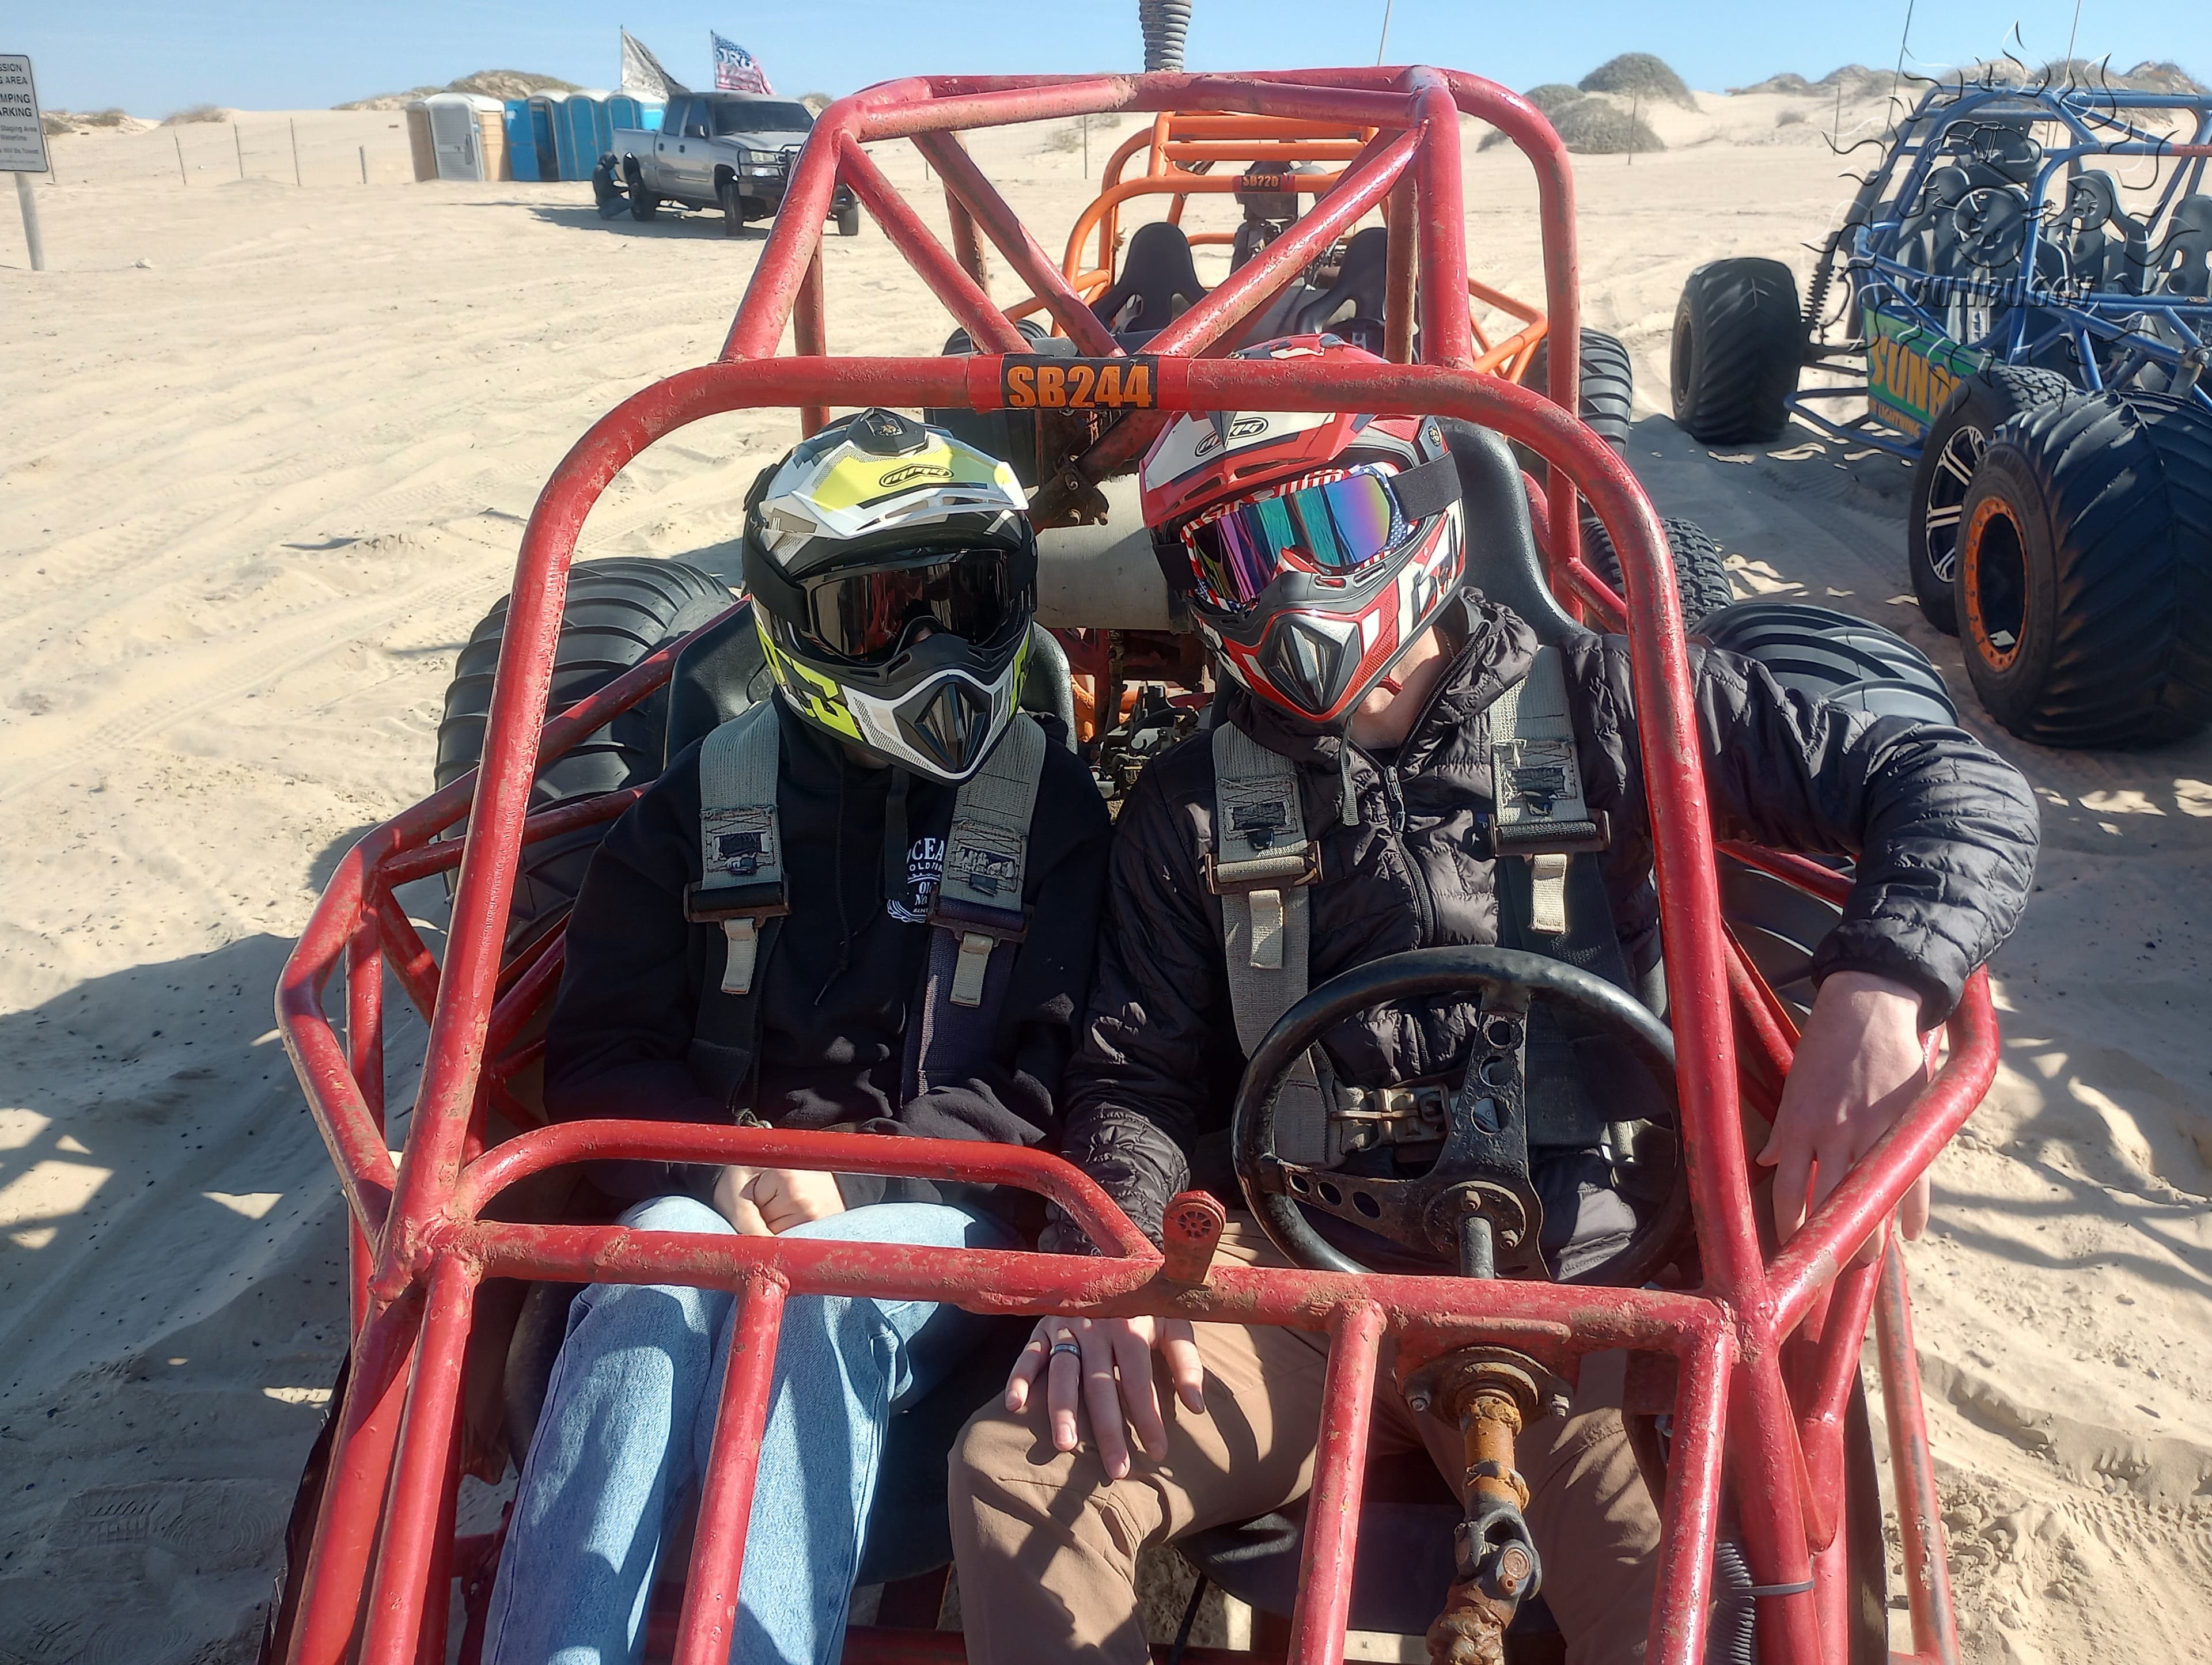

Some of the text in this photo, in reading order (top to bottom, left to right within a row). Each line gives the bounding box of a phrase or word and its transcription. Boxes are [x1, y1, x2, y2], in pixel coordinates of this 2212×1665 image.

[5, 76, 28, 84] AREA
[1007, 365, 1153, 408] SB244
[1871, 336, 1960, 416] SUNB
